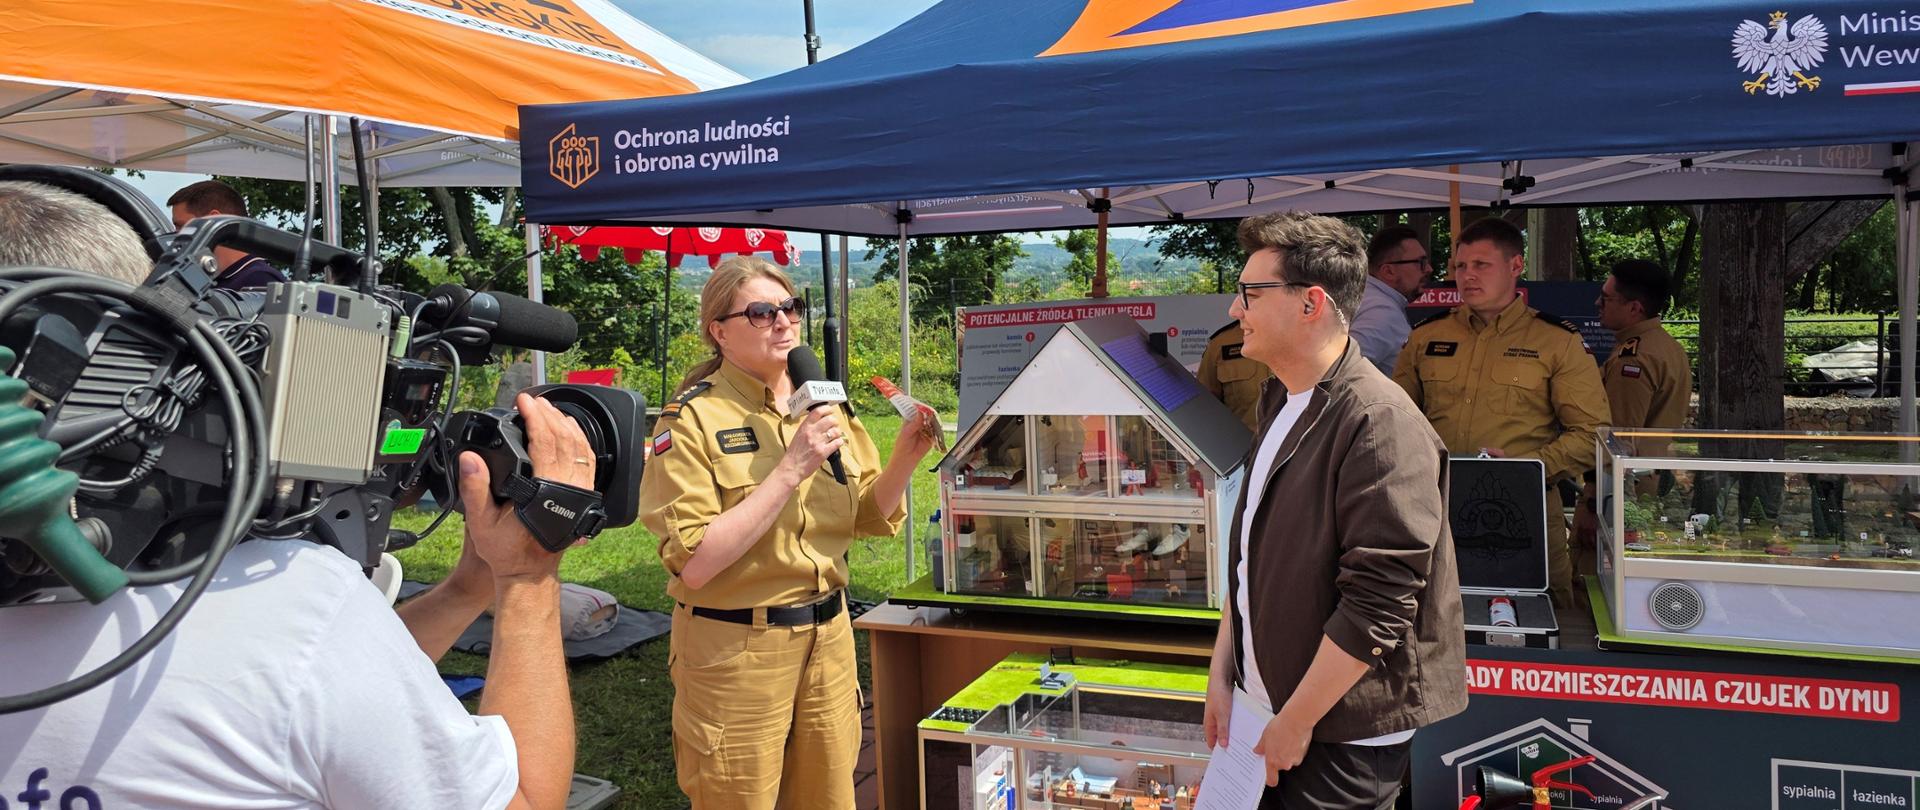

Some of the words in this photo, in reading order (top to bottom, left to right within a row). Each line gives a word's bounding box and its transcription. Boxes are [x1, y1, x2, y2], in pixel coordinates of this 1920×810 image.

[1840, 10, 1920, 36] Minis
[1839, 44, 1920, 68] Wew
[614, 128, 699, 149] Ochrona
[704, 115, 790, 142] ludności
[614, 154, 621, 175] i
[625, 153, 695, 174] obrona
[700, 143, 779, 170] cywilna
[970, 311, 1035, 326] POTENCJALNE
[1037, 307, 1074, 322] ŹRÓDŁA
[543, 499, 576, 520] Canon
[1511, 667, 1708, 702] ROZMIESZCZANIA
[1714, 680, 1811, 709] CZUJEK
[1818, 686, 1889, 713] DYMU
[1549, 790, 1566, 801] okój
[1783, 784, 1836, 799] sypialnia
[1853, 789, 1907, 806] łazienka
